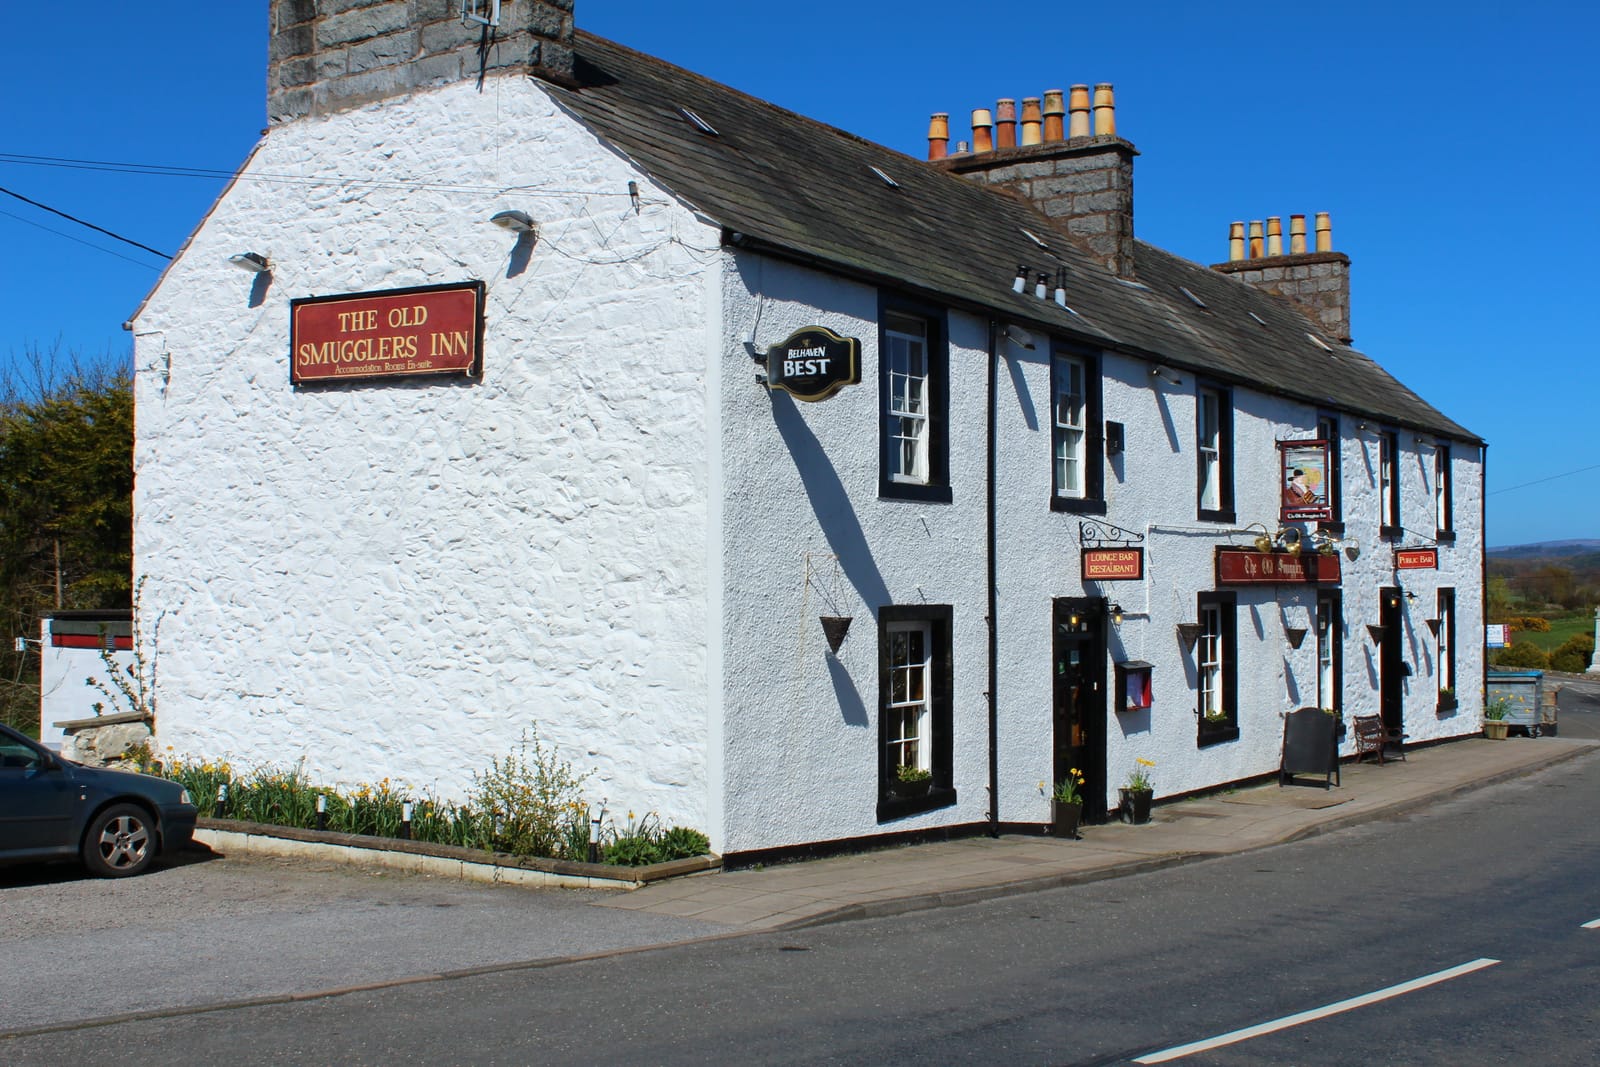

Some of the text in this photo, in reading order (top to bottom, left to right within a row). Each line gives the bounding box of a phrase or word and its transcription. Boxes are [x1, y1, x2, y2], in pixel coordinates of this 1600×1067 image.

[338, 305, 428, 333] THE OLD
[299, 330, 469, 366] SMUGGLERS INN
[787, 346, 826, 359] BELHAVEN
[335, 364, 382, 374] Accommodation
[384, 362, 406, 371] Rooms
[783, 359, 831, 377] BEST
[1090, 552, 1134, 562] LOUNGE BAR
[1090, 564, 1134, 574] RESTAURANT
[1244, 555, 1257, 577] The
